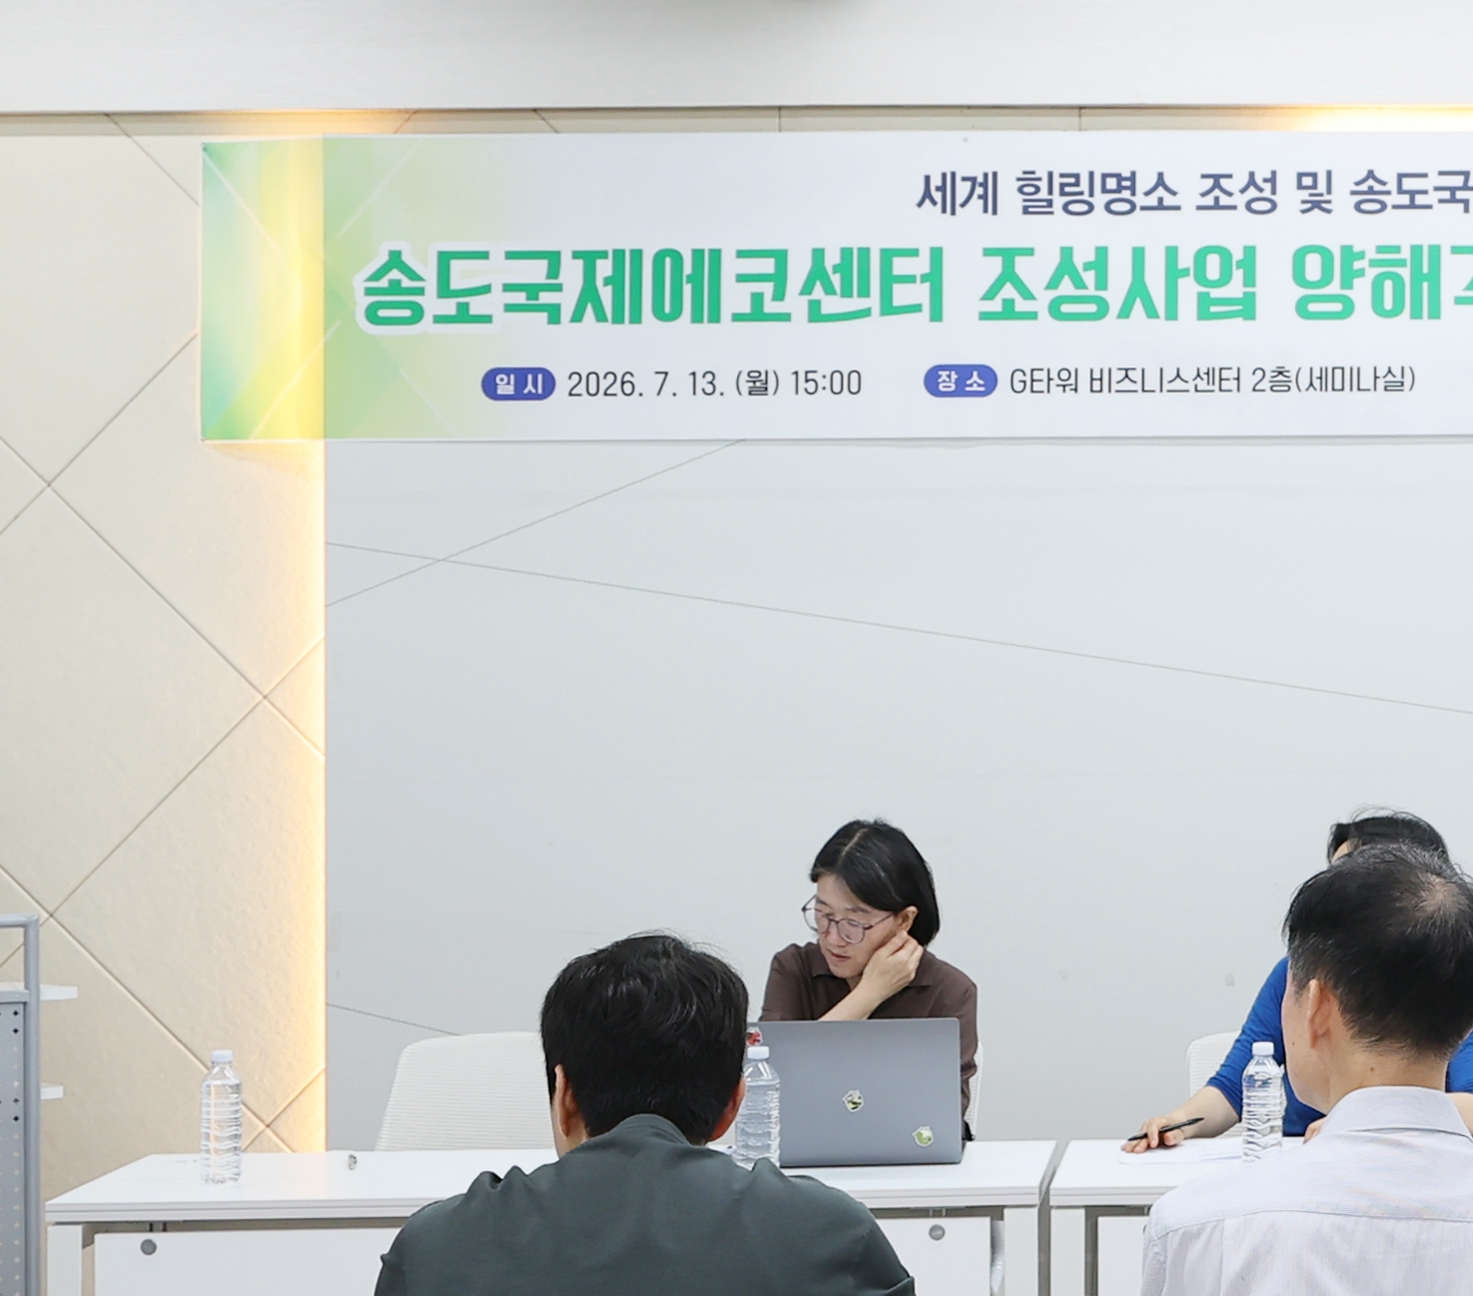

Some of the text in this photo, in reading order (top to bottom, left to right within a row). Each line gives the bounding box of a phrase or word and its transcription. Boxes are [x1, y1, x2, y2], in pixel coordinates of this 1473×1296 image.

[916, 171, 998, 216] 세계
[1016, 170, 1181, 216] 힐링명소
[1196, 170, 1277, 215] 조성
[1296, 170, 1333, 214] 및
[361, 246, 943, 326] 송도국제에코센터
[978, 245, 1256, 322] 조성사업
[568, 371, 643, 397] 2026.
[654, 371, 677, 397] 7.
[689, 371, 724, 396] 13.
[736, 370, 779, 396] (월)
[792, 370, 861, 395] 15:00
[1010, 368, 1078, 394] G타워
[1090, 367, 1240, 393] 비즈니스센터
[1252, 366, 1415, 393] 2층(세미나실)
